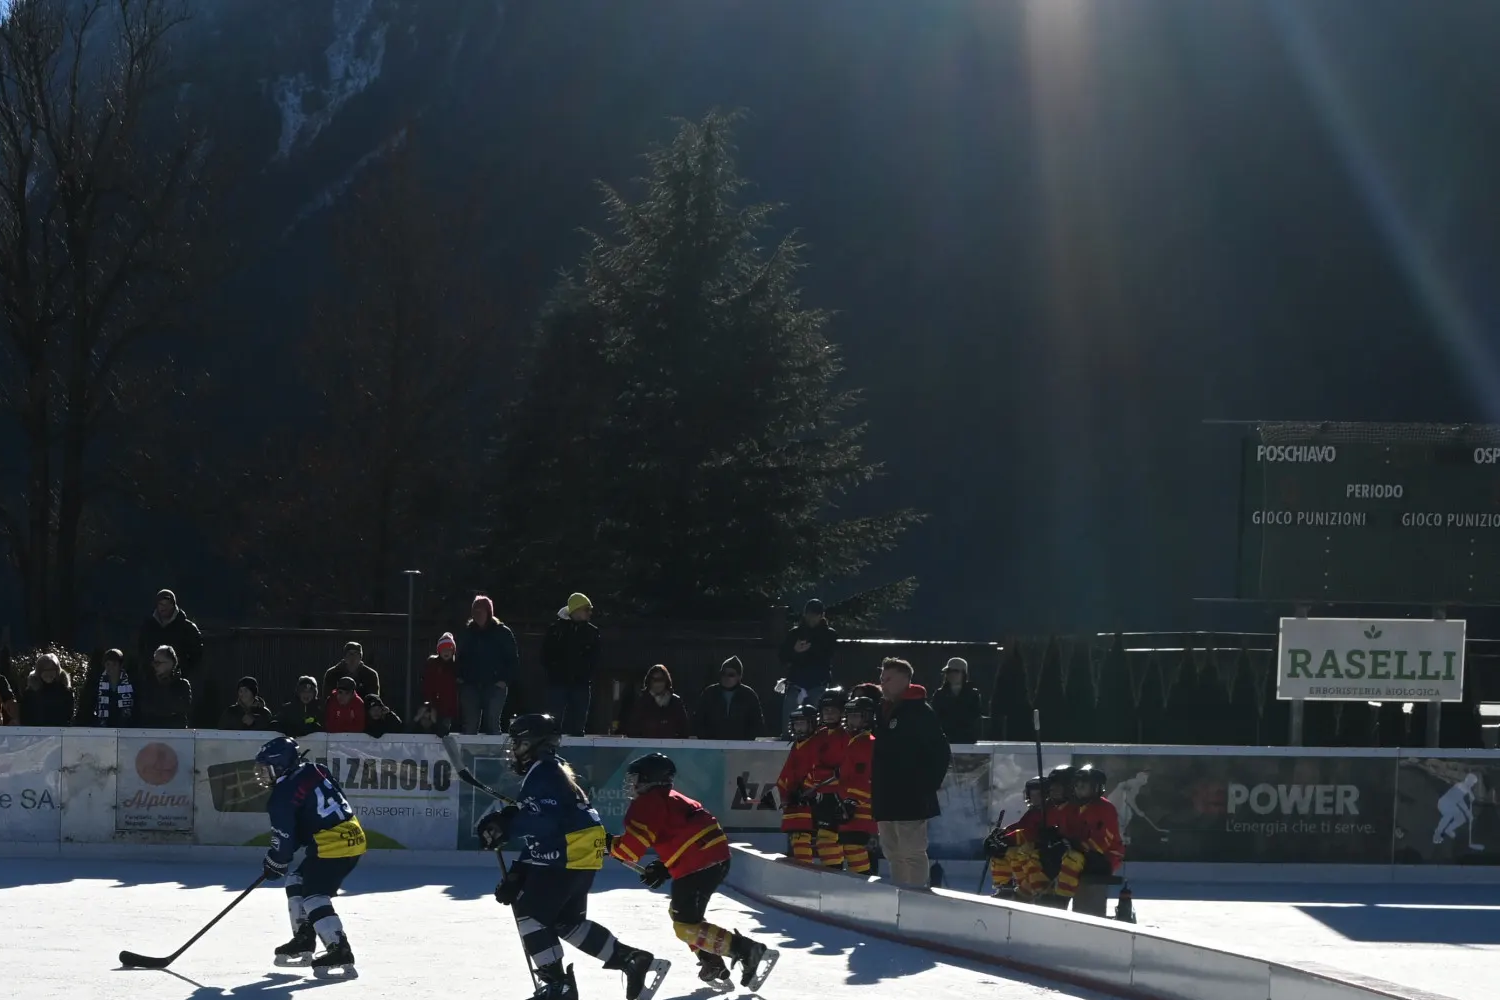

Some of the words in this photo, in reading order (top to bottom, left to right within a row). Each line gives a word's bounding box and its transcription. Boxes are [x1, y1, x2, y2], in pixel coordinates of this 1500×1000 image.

[1256, 445, 1336, 462] POSCHIAVO
[1346, 484, 1403, 498] PERIODO
[1252, 511, 1292, 525] GIOCO
[1297, 511, 1367, 526] PUNIZIONI
[1402, 512, 1442, 526] GIOCO
[1287, 648, 1457, 681] RASELLI
[1309, 687, 1381, 696] ERBORISTERIA
[1385, 687, 1440, 697] BIOLOGICA
[315, 757, 451, 793] LZAROLO
[20, 788, 56, 809] SA
[122, 789, 190, 811] Alpina
[1226, 782, 1361, 815] POWER
[354, 806, 415, 817] TRASPORTI
[1225, 819, 1288, 837] L'energia
[1292, 819, 1317, 834] che
[1321, 820, 1330, 833] ti
[1334, 822, 1377, 834] serve.
